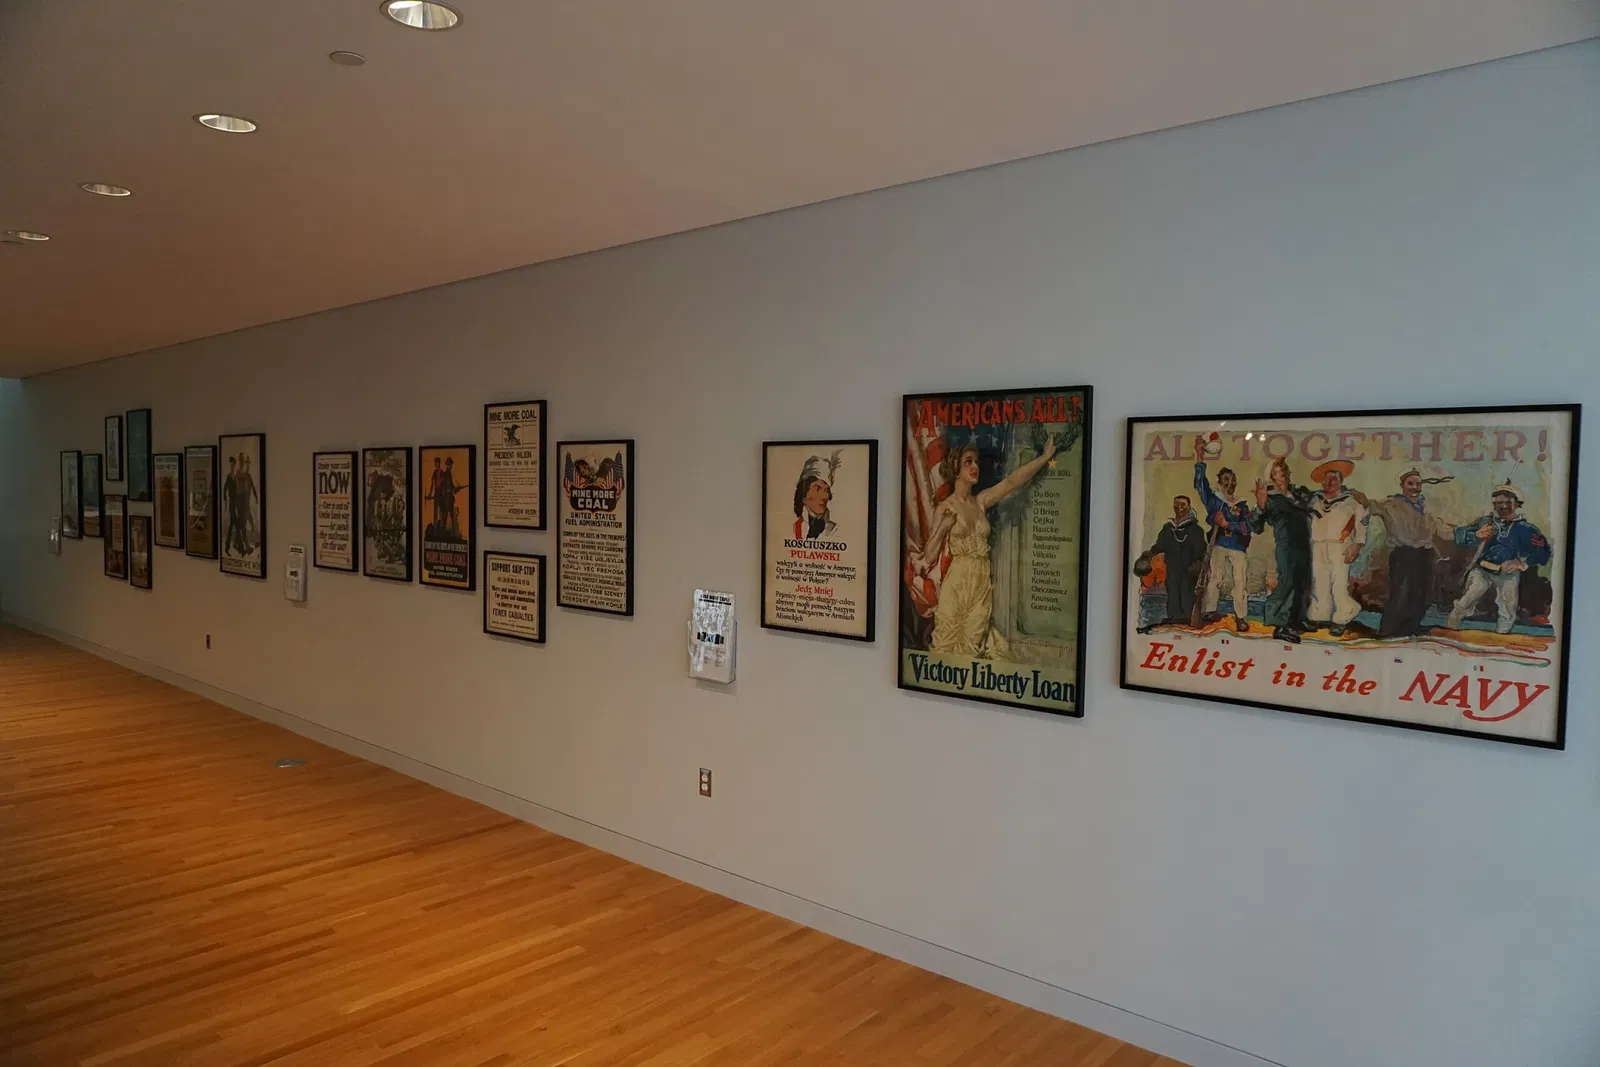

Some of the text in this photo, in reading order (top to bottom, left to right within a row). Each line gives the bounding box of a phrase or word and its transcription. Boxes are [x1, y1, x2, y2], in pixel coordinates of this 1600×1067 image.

[913, 395, 1081, 438] AMERICANS ALL!
[572, 489, 615, 499] MINE MORE
[578, 498, 609, 510] COAL
[571, 511, 616, 521] UNITED STATES
[565, 518, 623, 529] FUEL ADMINISTRATION
[790, 549, 841, 561] PULAWSKI
[1032, 560, 1050, 568] Levy
[1030, 603, 1062, 612] Gonzales
[908, 653, 1076, 703] Victory Liberty Loan
[1139, 641, 1550, 722] Enlist in the NAVY
